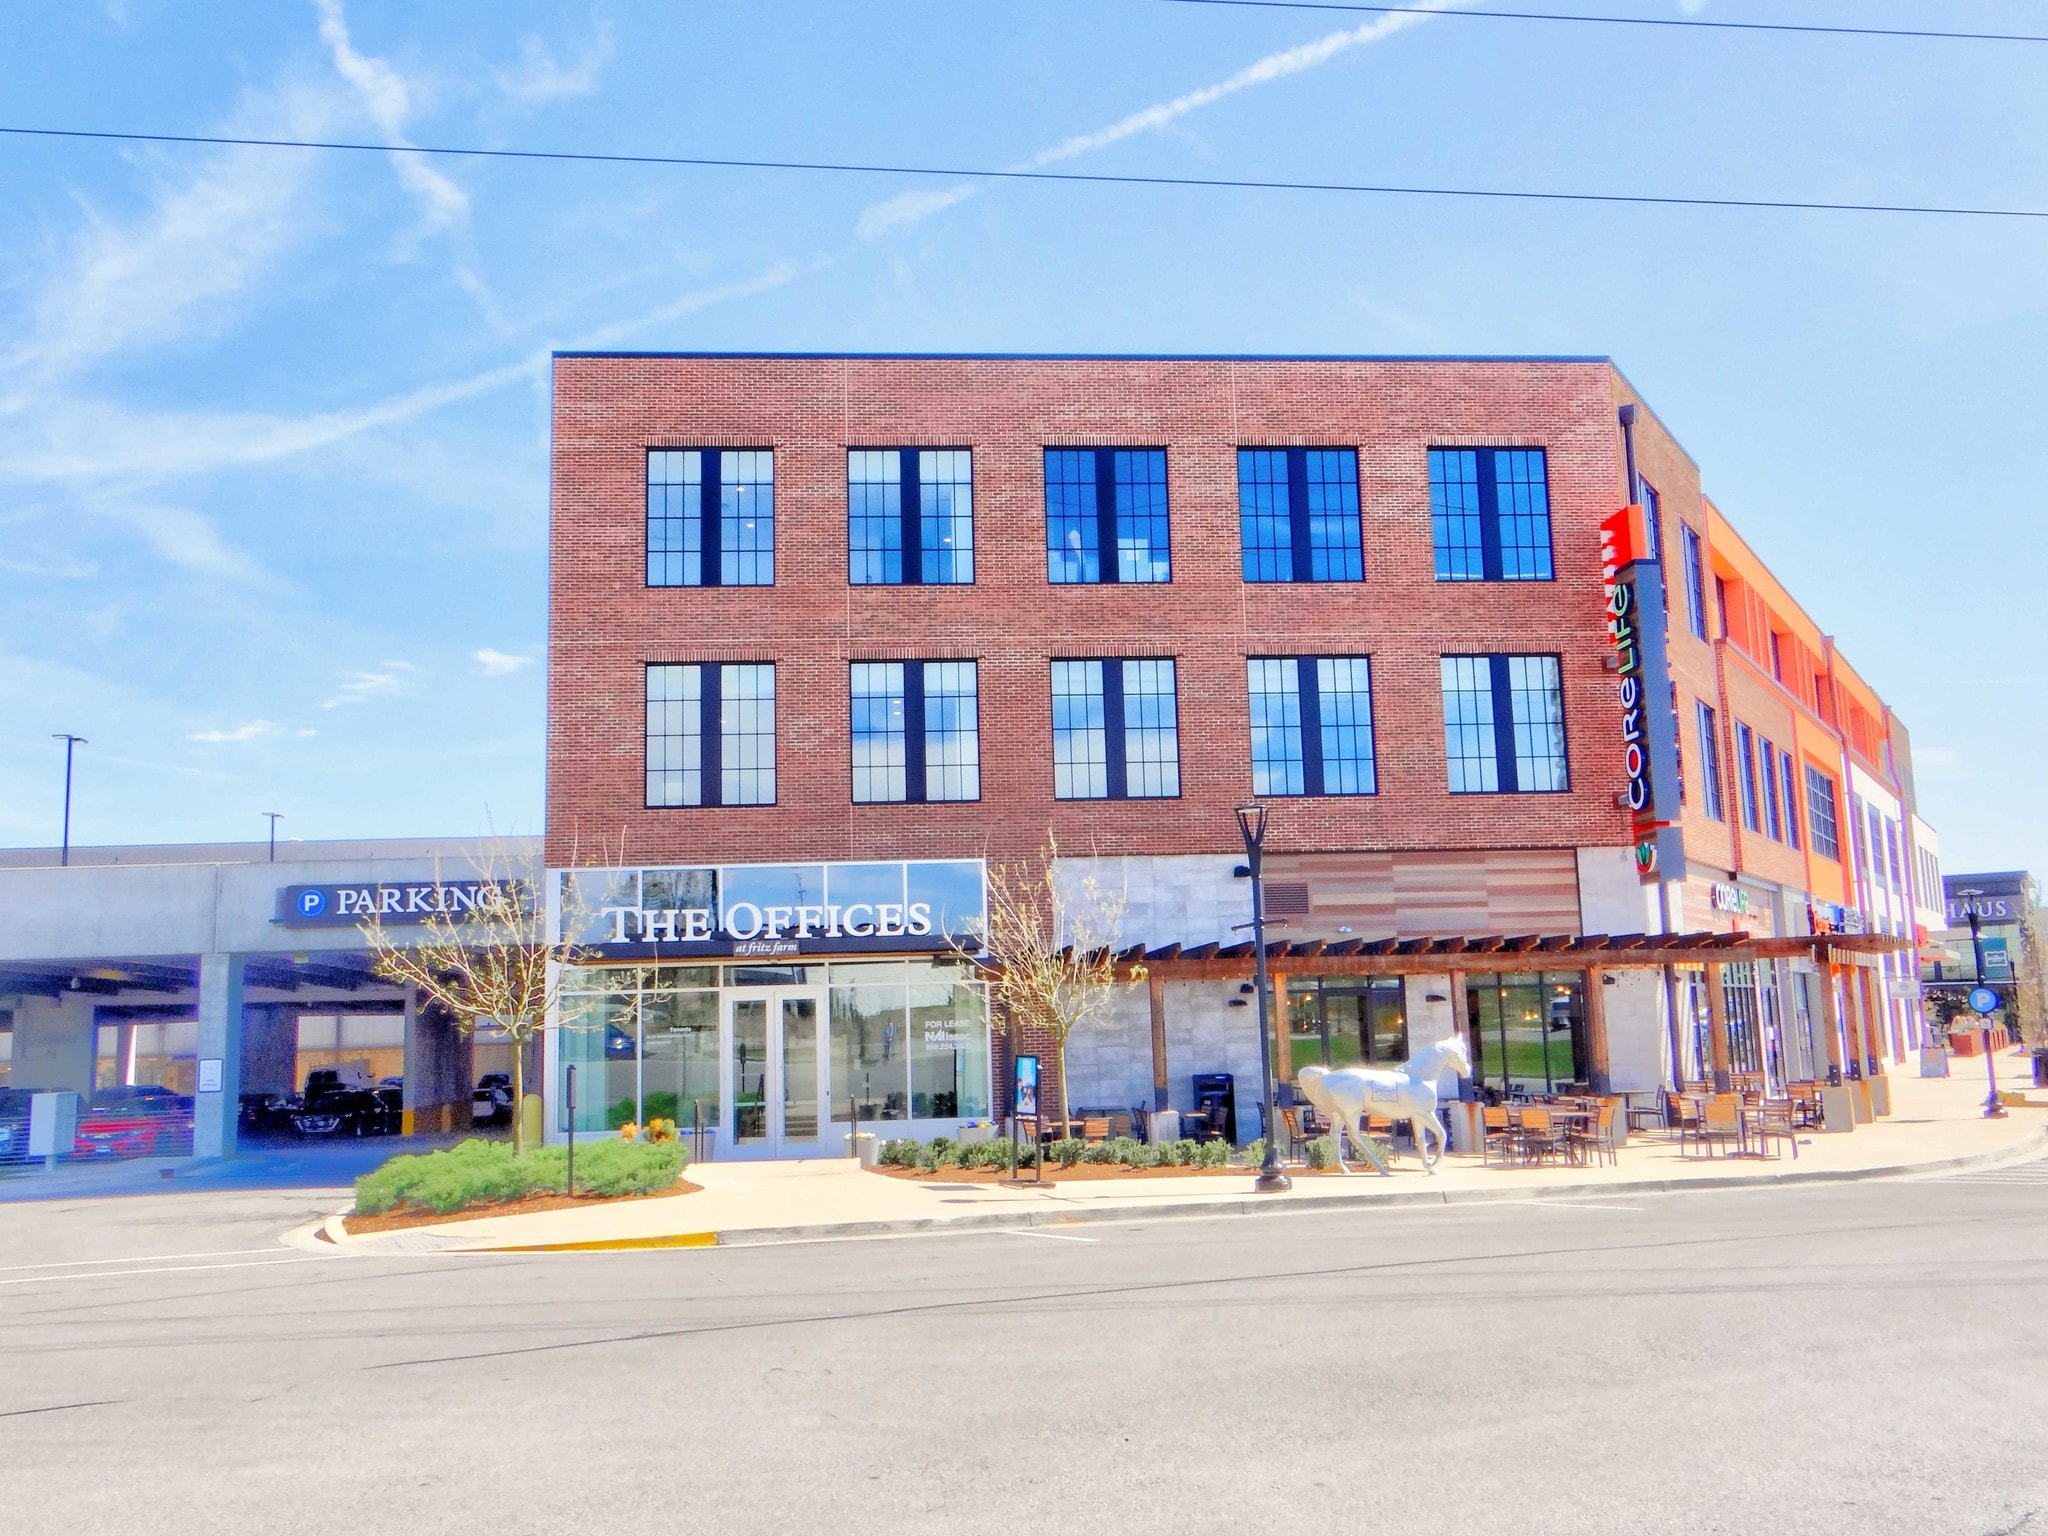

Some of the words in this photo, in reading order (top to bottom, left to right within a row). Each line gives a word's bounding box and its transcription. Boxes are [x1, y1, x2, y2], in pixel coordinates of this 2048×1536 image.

[304, 894, 320, 912] P
[336, 886, 504, 915] PARKING
[600, 905, 712, 943] THE
[725, 901, 932, 940] OFFICES
[735, 944, 747, 953] at
[745, 941, 772, 956] fritz
[770, 941, 797, 955] farm
[1975, 992, 1991, 1008] P
[925, 1020, 943, 1029] FOR
[944, 1019, 970, 1028] LEASE
